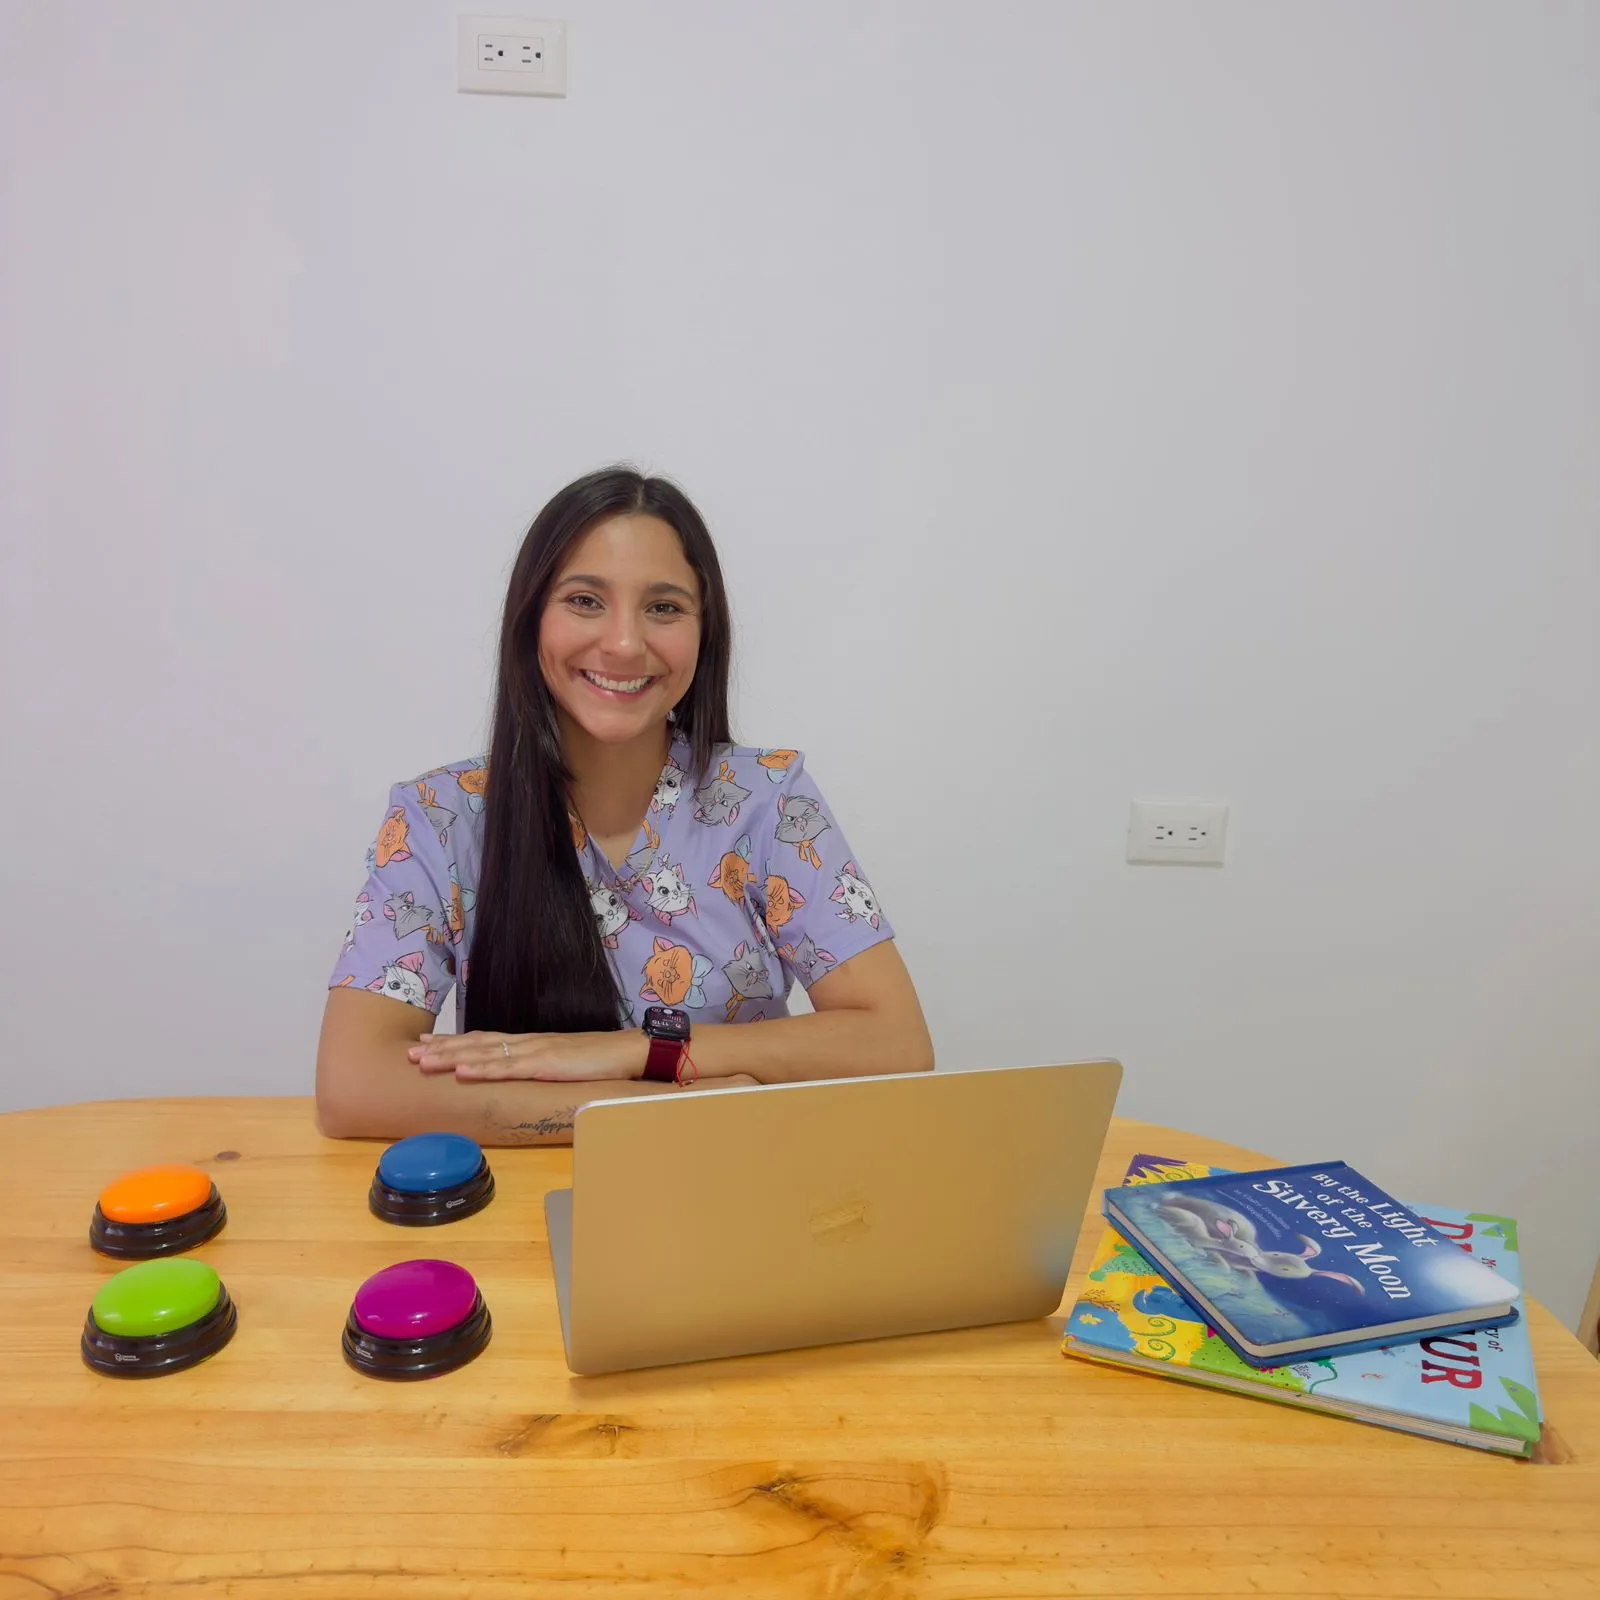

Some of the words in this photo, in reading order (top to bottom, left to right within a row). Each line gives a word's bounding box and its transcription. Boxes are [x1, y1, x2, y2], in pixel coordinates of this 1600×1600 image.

[511, 1117, 575, 1136] unstoppa
[1311, 1173, 1340, 1188] By
[1337, 1184, 1369, 1204] the
[1367, 1202, 1440, 1248] Light
[1316, 1192, 1344, 1206] of
[1340, 1207, 1373, 1229] the
[1252, 1180, 1358, 1239] Silvery
[1344, 1241, 1412, 1300] Moon
[1487, 1340, 1504, 1352] of
